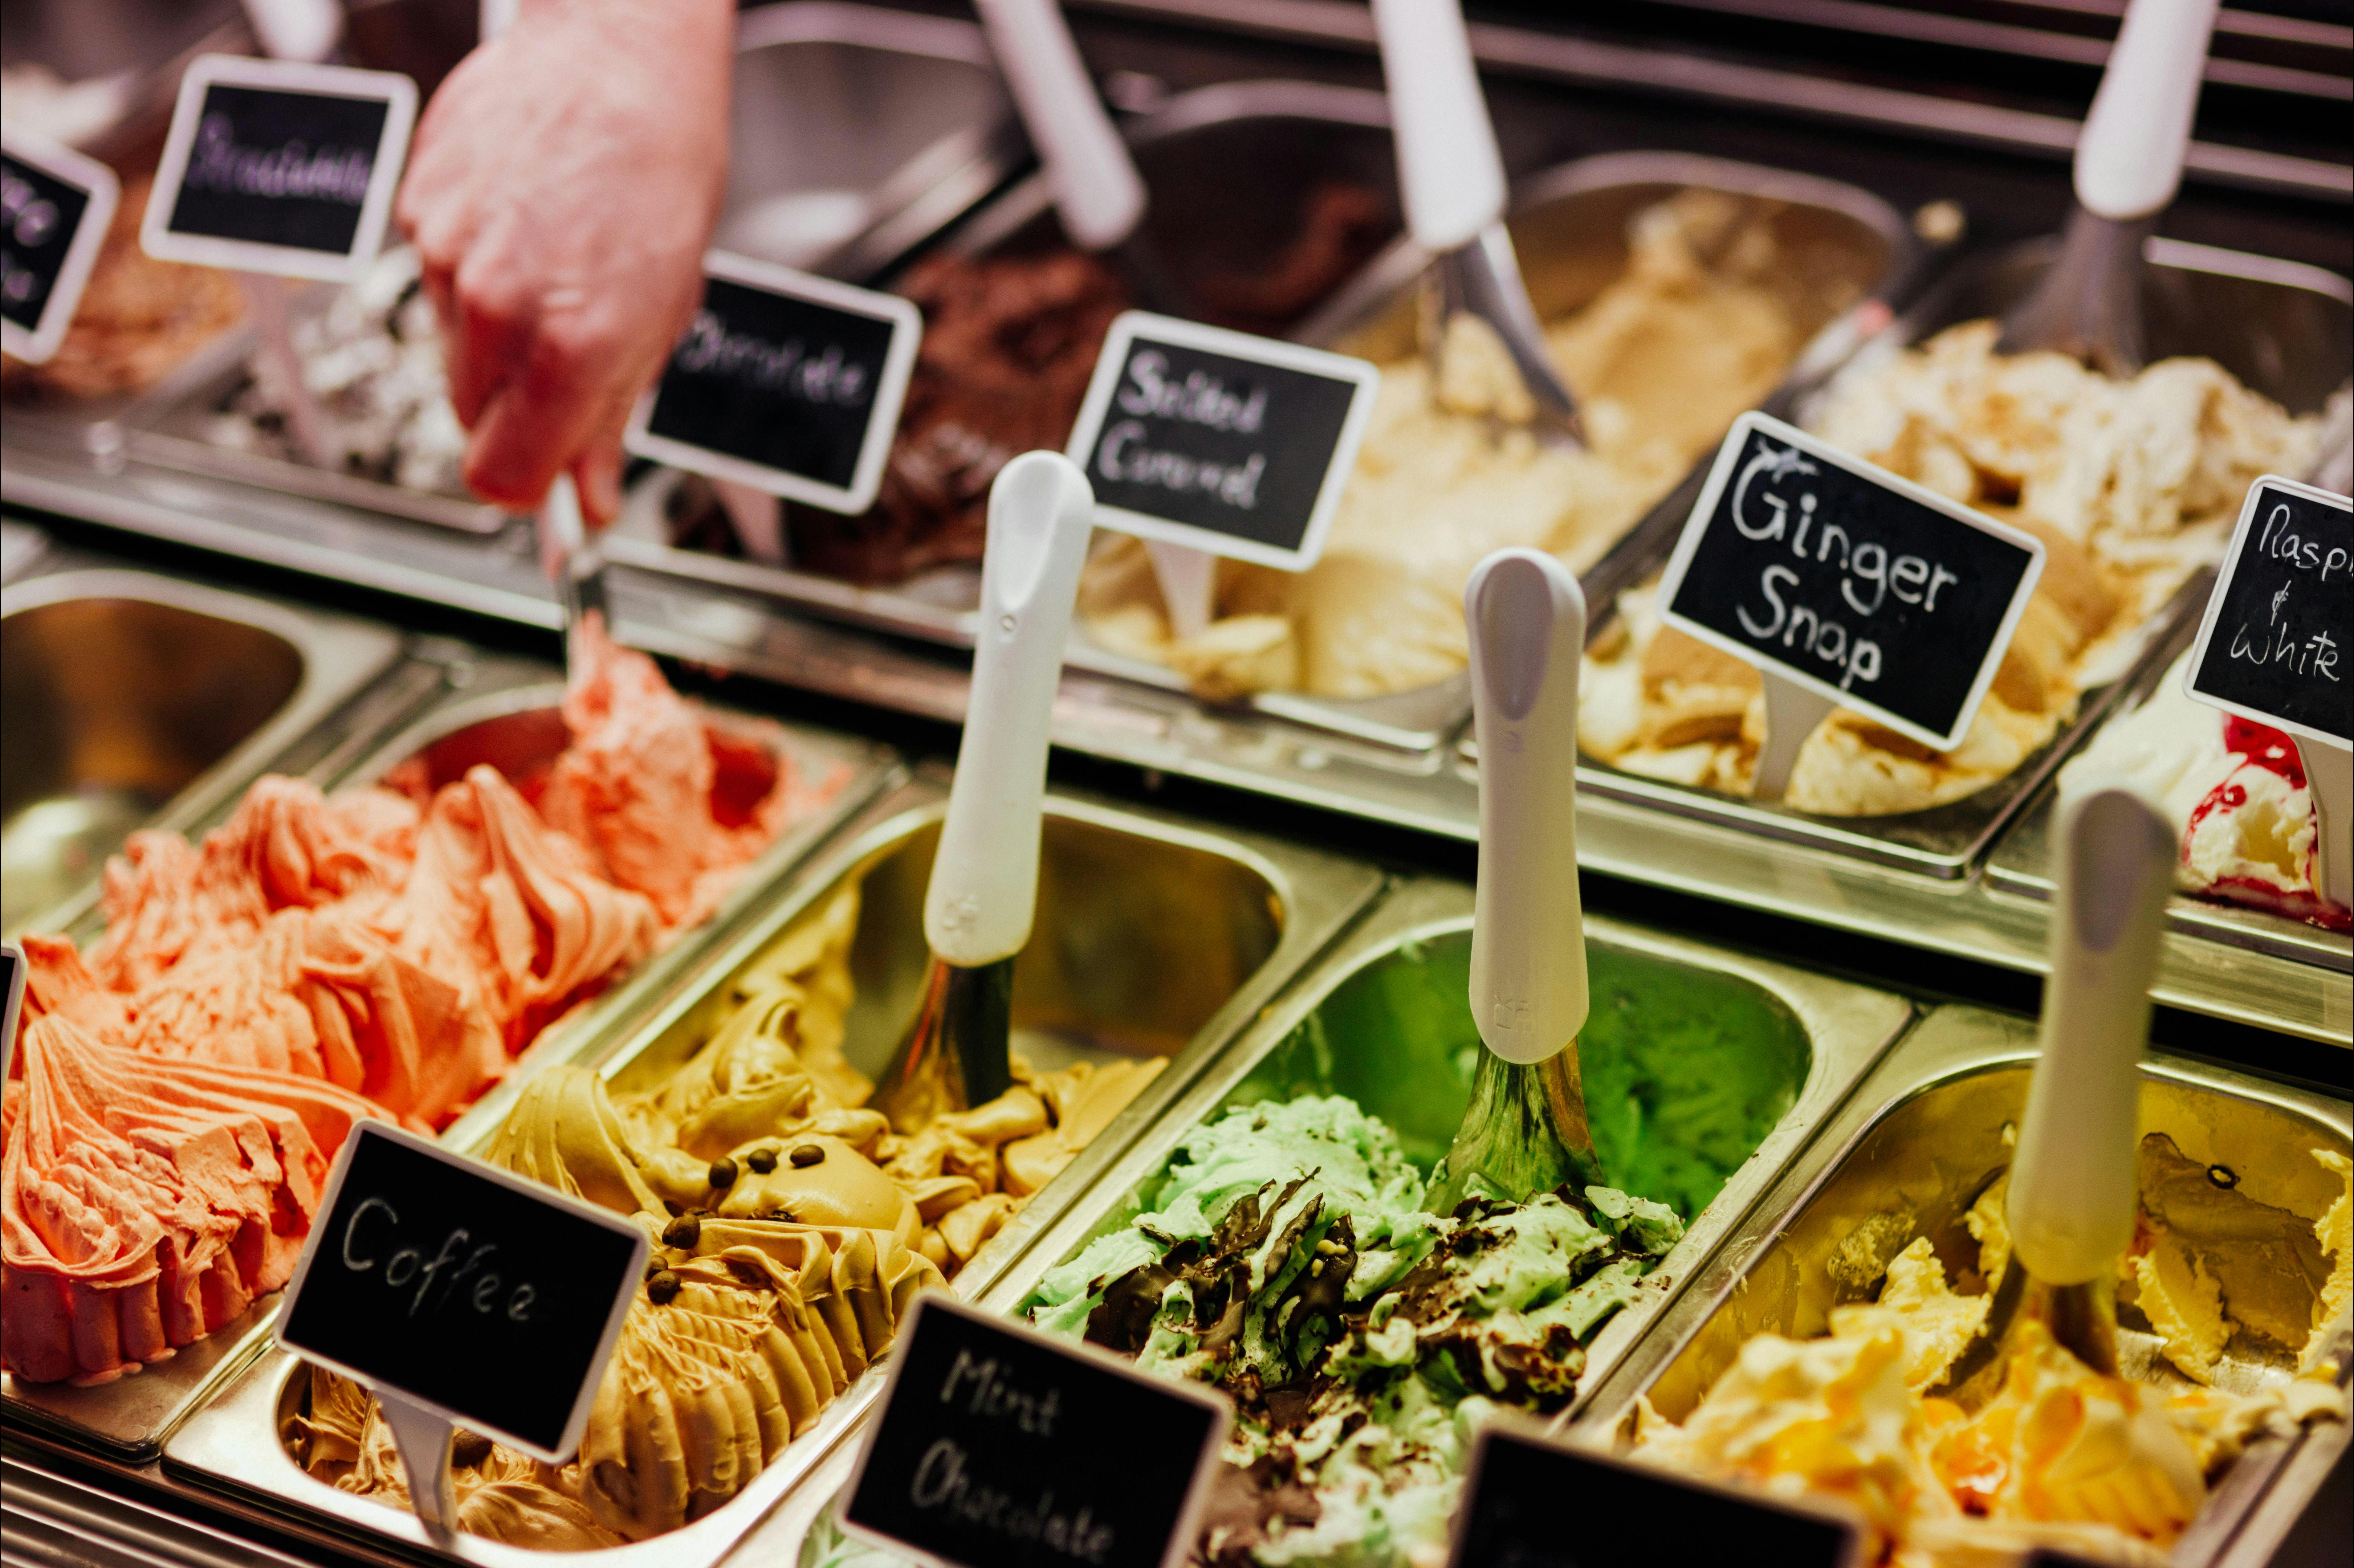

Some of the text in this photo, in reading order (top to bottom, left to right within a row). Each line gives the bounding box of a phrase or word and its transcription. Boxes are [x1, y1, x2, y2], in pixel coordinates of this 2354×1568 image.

[1732, 449, 1960, 616] Ginger
[2260, 503, 2354, 581] Rasp
[1737, 564, 1882, 691] Snap
[341, 1196, 537, 1322] Coffee
[938, 1346, 1061, 1438] Mint
